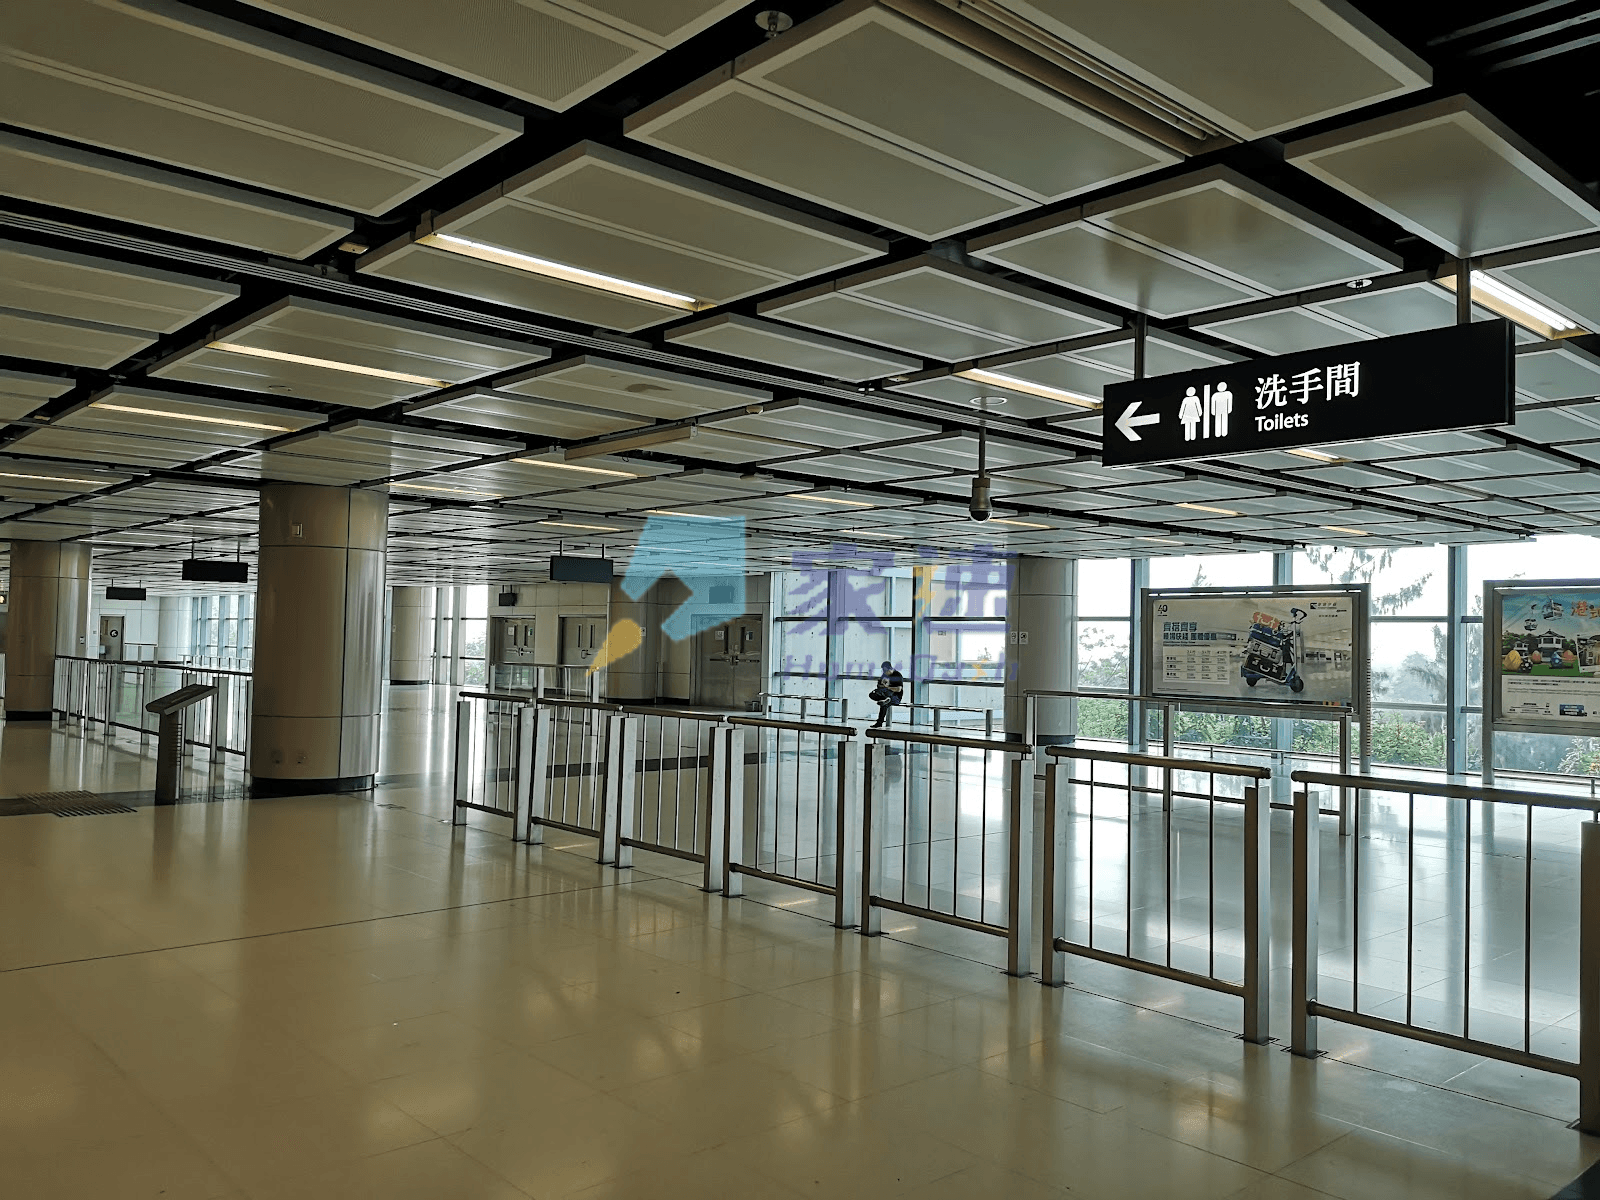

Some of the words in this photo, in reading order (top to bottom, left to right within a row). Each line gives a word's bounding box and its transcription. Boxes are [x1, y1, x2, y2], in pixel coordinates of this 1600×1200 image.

[1254, 361, 1361, 410] 洗手間
[1255, 412, 1309, 433] Toilets
